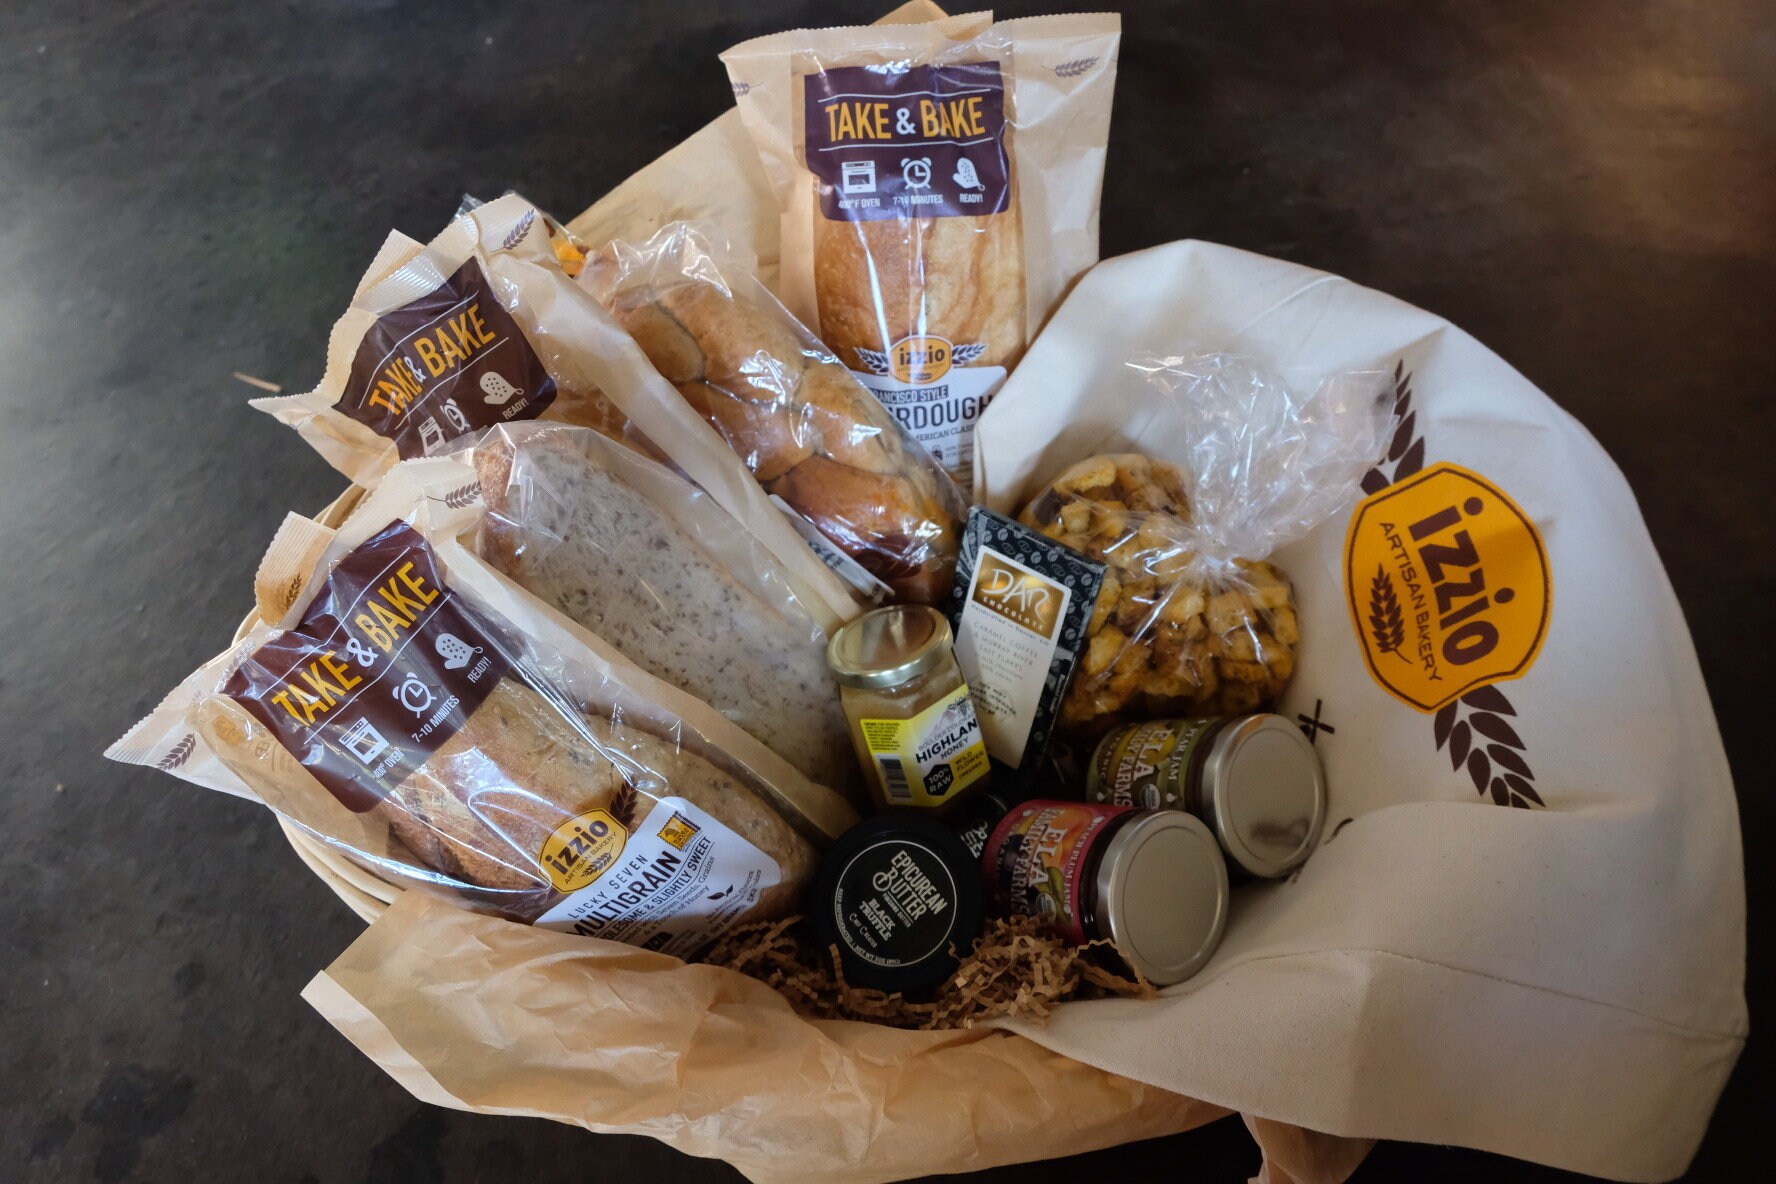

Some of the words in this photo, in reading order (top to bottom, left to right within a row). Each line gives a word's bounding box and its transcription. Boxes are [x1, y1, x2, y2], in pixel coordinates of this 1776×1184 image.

[825, 102, 892, 142] TAKE
[895, 108, 916, 135] &
[920, 97, 986, 138] BAKE
[861, 198, 880, 208] OVEN
[910, 194, 944, 205] MINUTES
[959, 193, 983, 203] READY!
[414, 303, 496, 378] BAKE
[900, 345, 945, 366] izzio
[369, 357, 423, 415] TAKE
[404, 356, 426, 382] &
[502, 397, 529, 420] READY!
[920, 386, 948, 401] STYLE
[889, 395, 993, 431] RDOUGH
[981, 568, 1050, 623] DAR
[1408, 497, 1515, 666] izzio
[355, 562, 439, 653] BAKE
[983, 596, 1045, 631] CHOCOLATE
[1379, 521, 1425, 611] ARTISAN
[1416, 610, 1443, 682] BAKERY
[346, 637, 378, 668] &
[467, 657, 492, 684] READY!
[272, 651, 363, 727] TAKE
[411, 723, 433, 743] 7-10
[430, 695, 460, 727] MINUTES
[385, 747, 406, 770] OVEN
[940, 737, 969, 760] HONEY
[954, 751, 974, 765] WILD
[956, 751, 985, 772] FLOWER
[1133, 728, 1174, 781] ELA
[929, 775, 952, 793] RAW
[1168, 756, 1182, 780] JAM
[545, 819, 609, 877] izzio
[564, 854, 592, 885] ARTISAN
[589, 831, 617, 857] BAKERY
[1028, 827, 1068, 888] ELA
[1065, 850, 1080, 879] PLUM
[565, 850, 682, 937] MULTIGRAIN
[568, 891, 609, 919] LUCKY
[609, 854, 649, 890] SEVEN
[601, 908, 647, 940] OLESOME
[652, 870, 693, 905] SLIGHTLY
[688, 836, 712, 872] SWEET
[656, 901, 678, 916] Seven
[698, 856, 715, 884] Grains
[685, 885, 710, 905] Honey
[873, 867, 928, 921] BUTTER
[891, 850, 948, 915] EPICUREAN
[859, 900, 892, 941] TRUFFLE
[868, 898, 896, 931] BLACK
